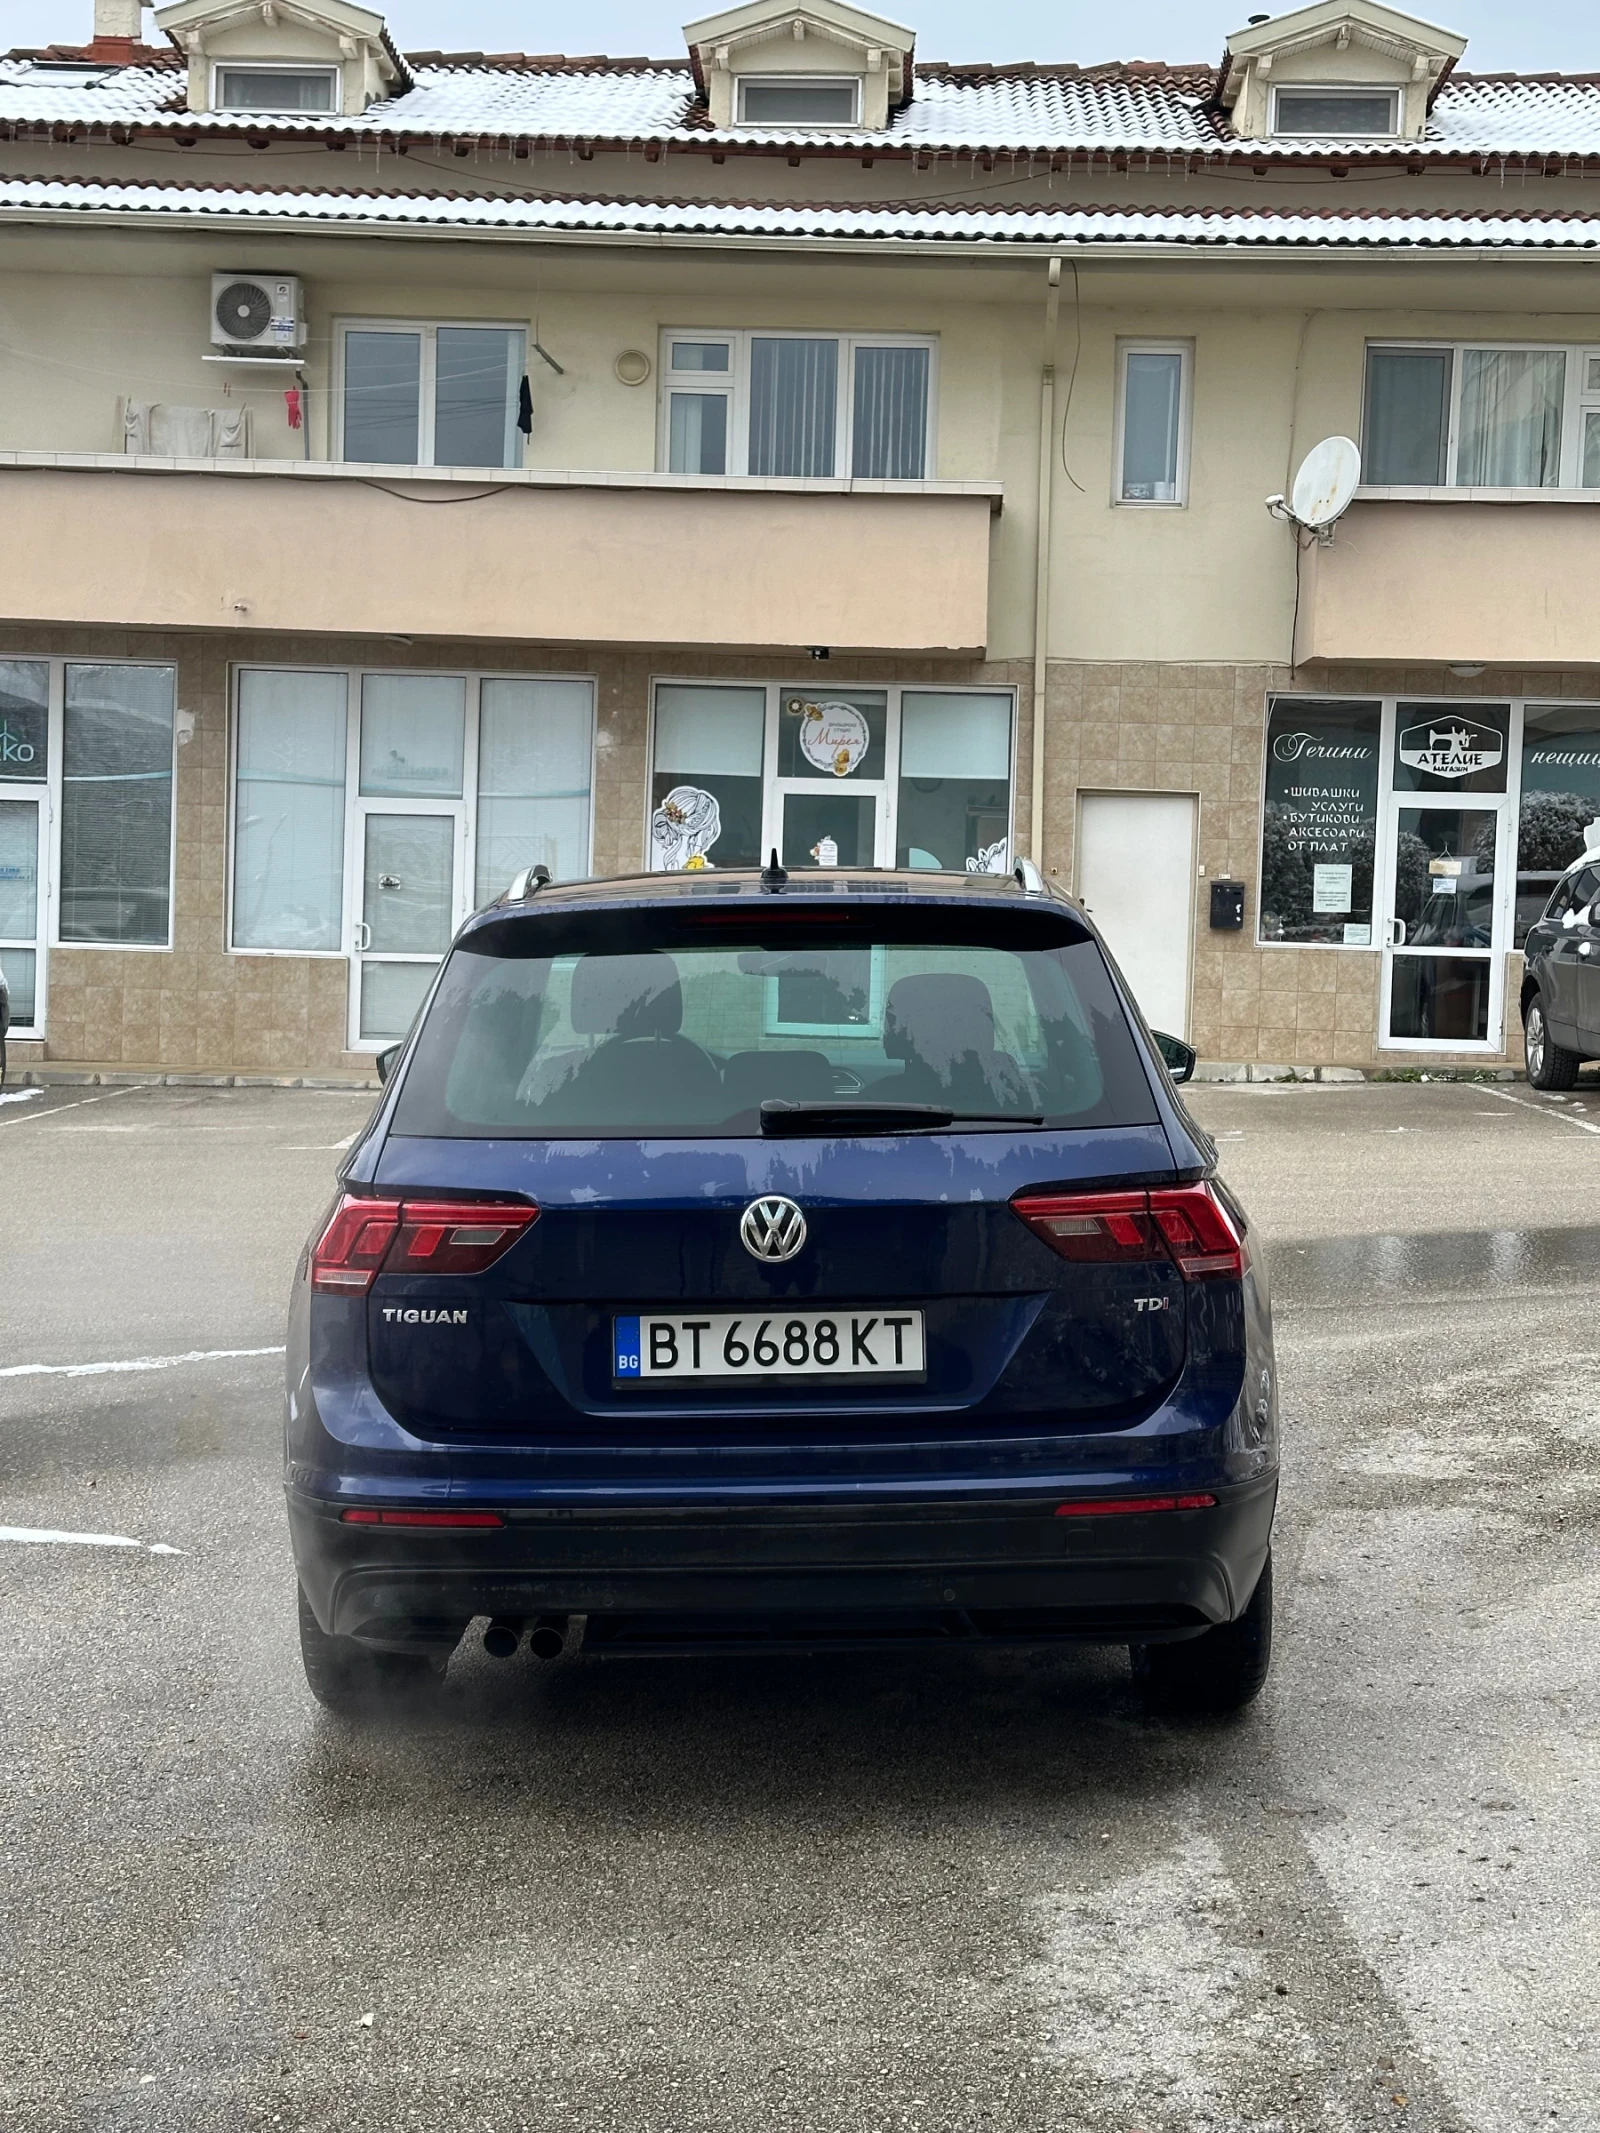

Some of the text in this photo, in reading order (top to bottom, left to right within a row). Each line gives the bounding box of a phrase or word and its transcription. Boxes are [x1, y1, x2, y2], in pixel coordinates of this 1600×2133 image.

[0, 735, 34, 762] ko
[808, 727, 862, 759] Мирея
[1417, 752, 1483, 766] АТЕЛИЕ
[1432, 765, 1469, 773] МАГАЗИН
[1290, 786, 1360, 798] ШИВАШКИ
[1310, 801, 1364, 812] УСЛУГИ
[1289, 812, 1360, 824] БУТИКОВИ
[1288, 827, 1365, 838] АКСЕСОАРИ
[1287, 840, 1349, 852] ОТ ПЛАТ
[382, 1308, 468, 1324] TIGUAN
[618, 1317, 913, 1370] BG BT 6688 KT
